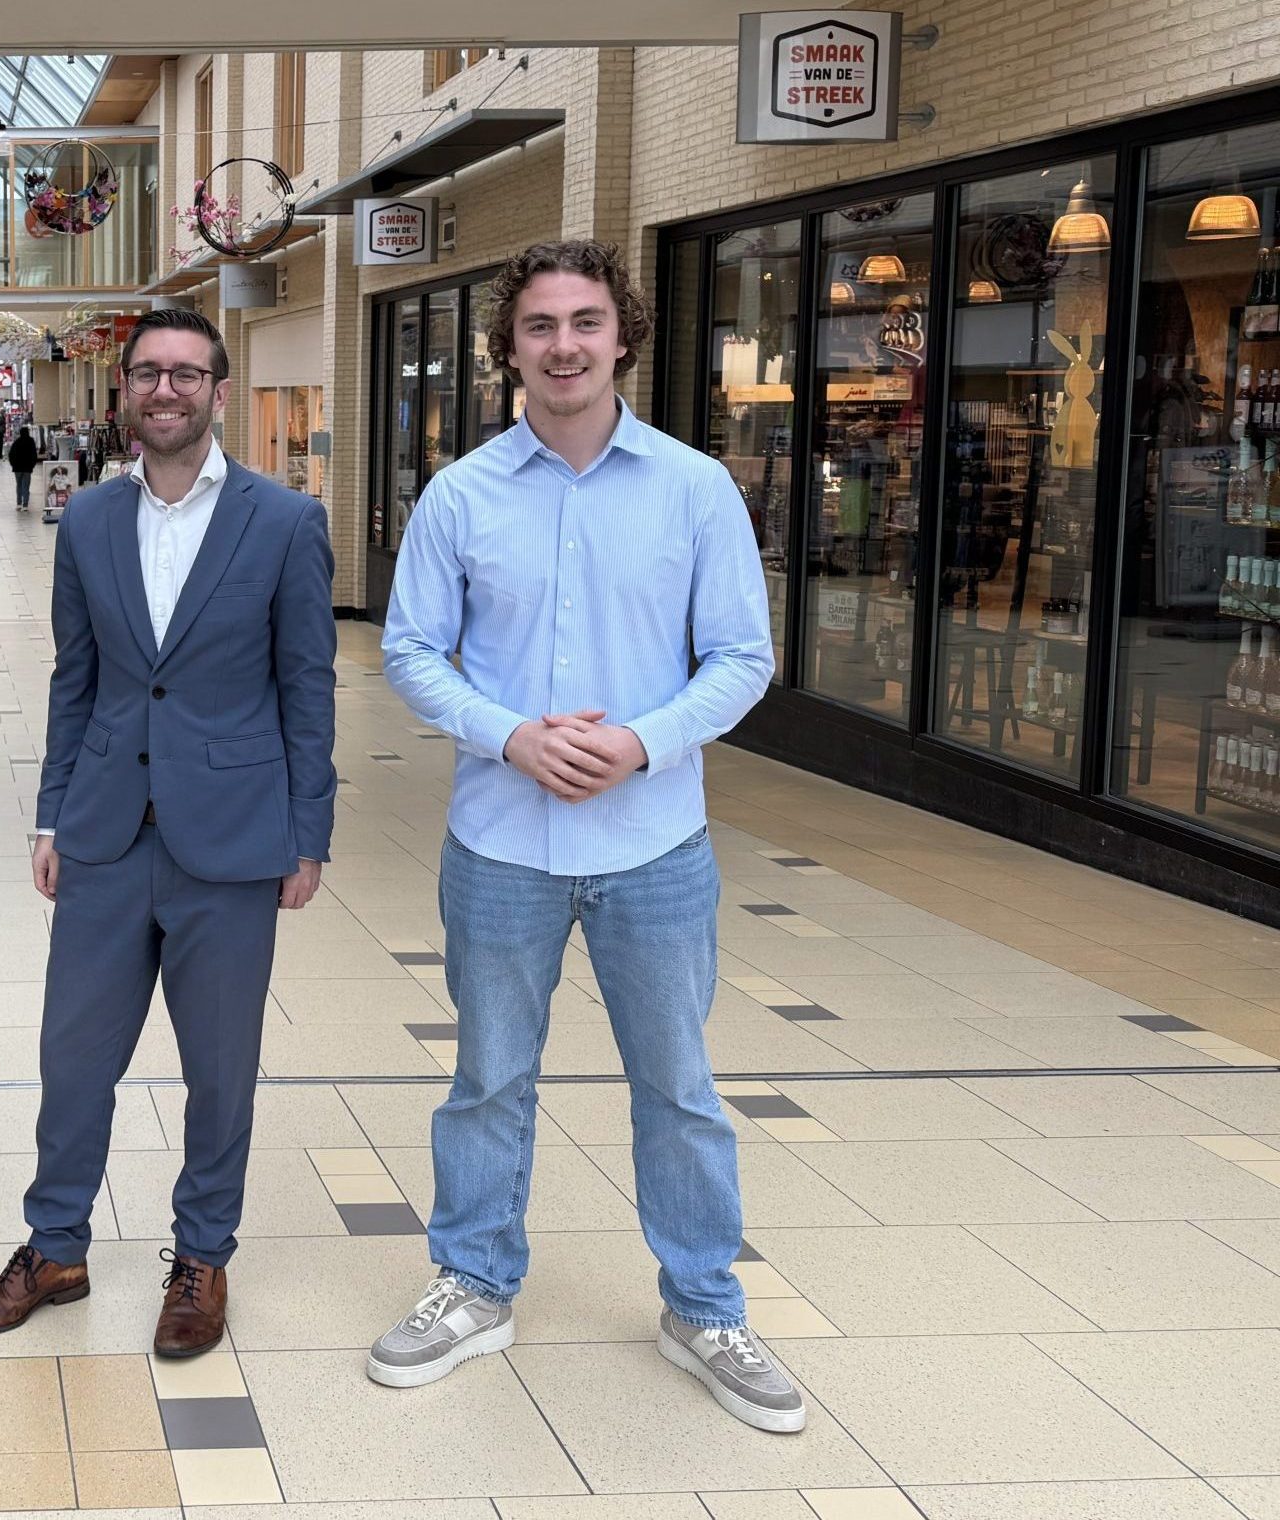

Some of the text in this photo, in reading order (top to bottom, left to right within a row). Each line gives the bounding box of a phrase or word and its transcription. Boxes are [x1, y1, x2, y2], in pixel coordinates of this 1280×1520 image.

[790, 44, 865, 63] SMAAK
[804, 68, 853, 81] VAN DE
[787, 85, 865, 105] STREEK
[378, 214, 418, 226] SMAAK
[376, 235, 418, 247] STREEK
